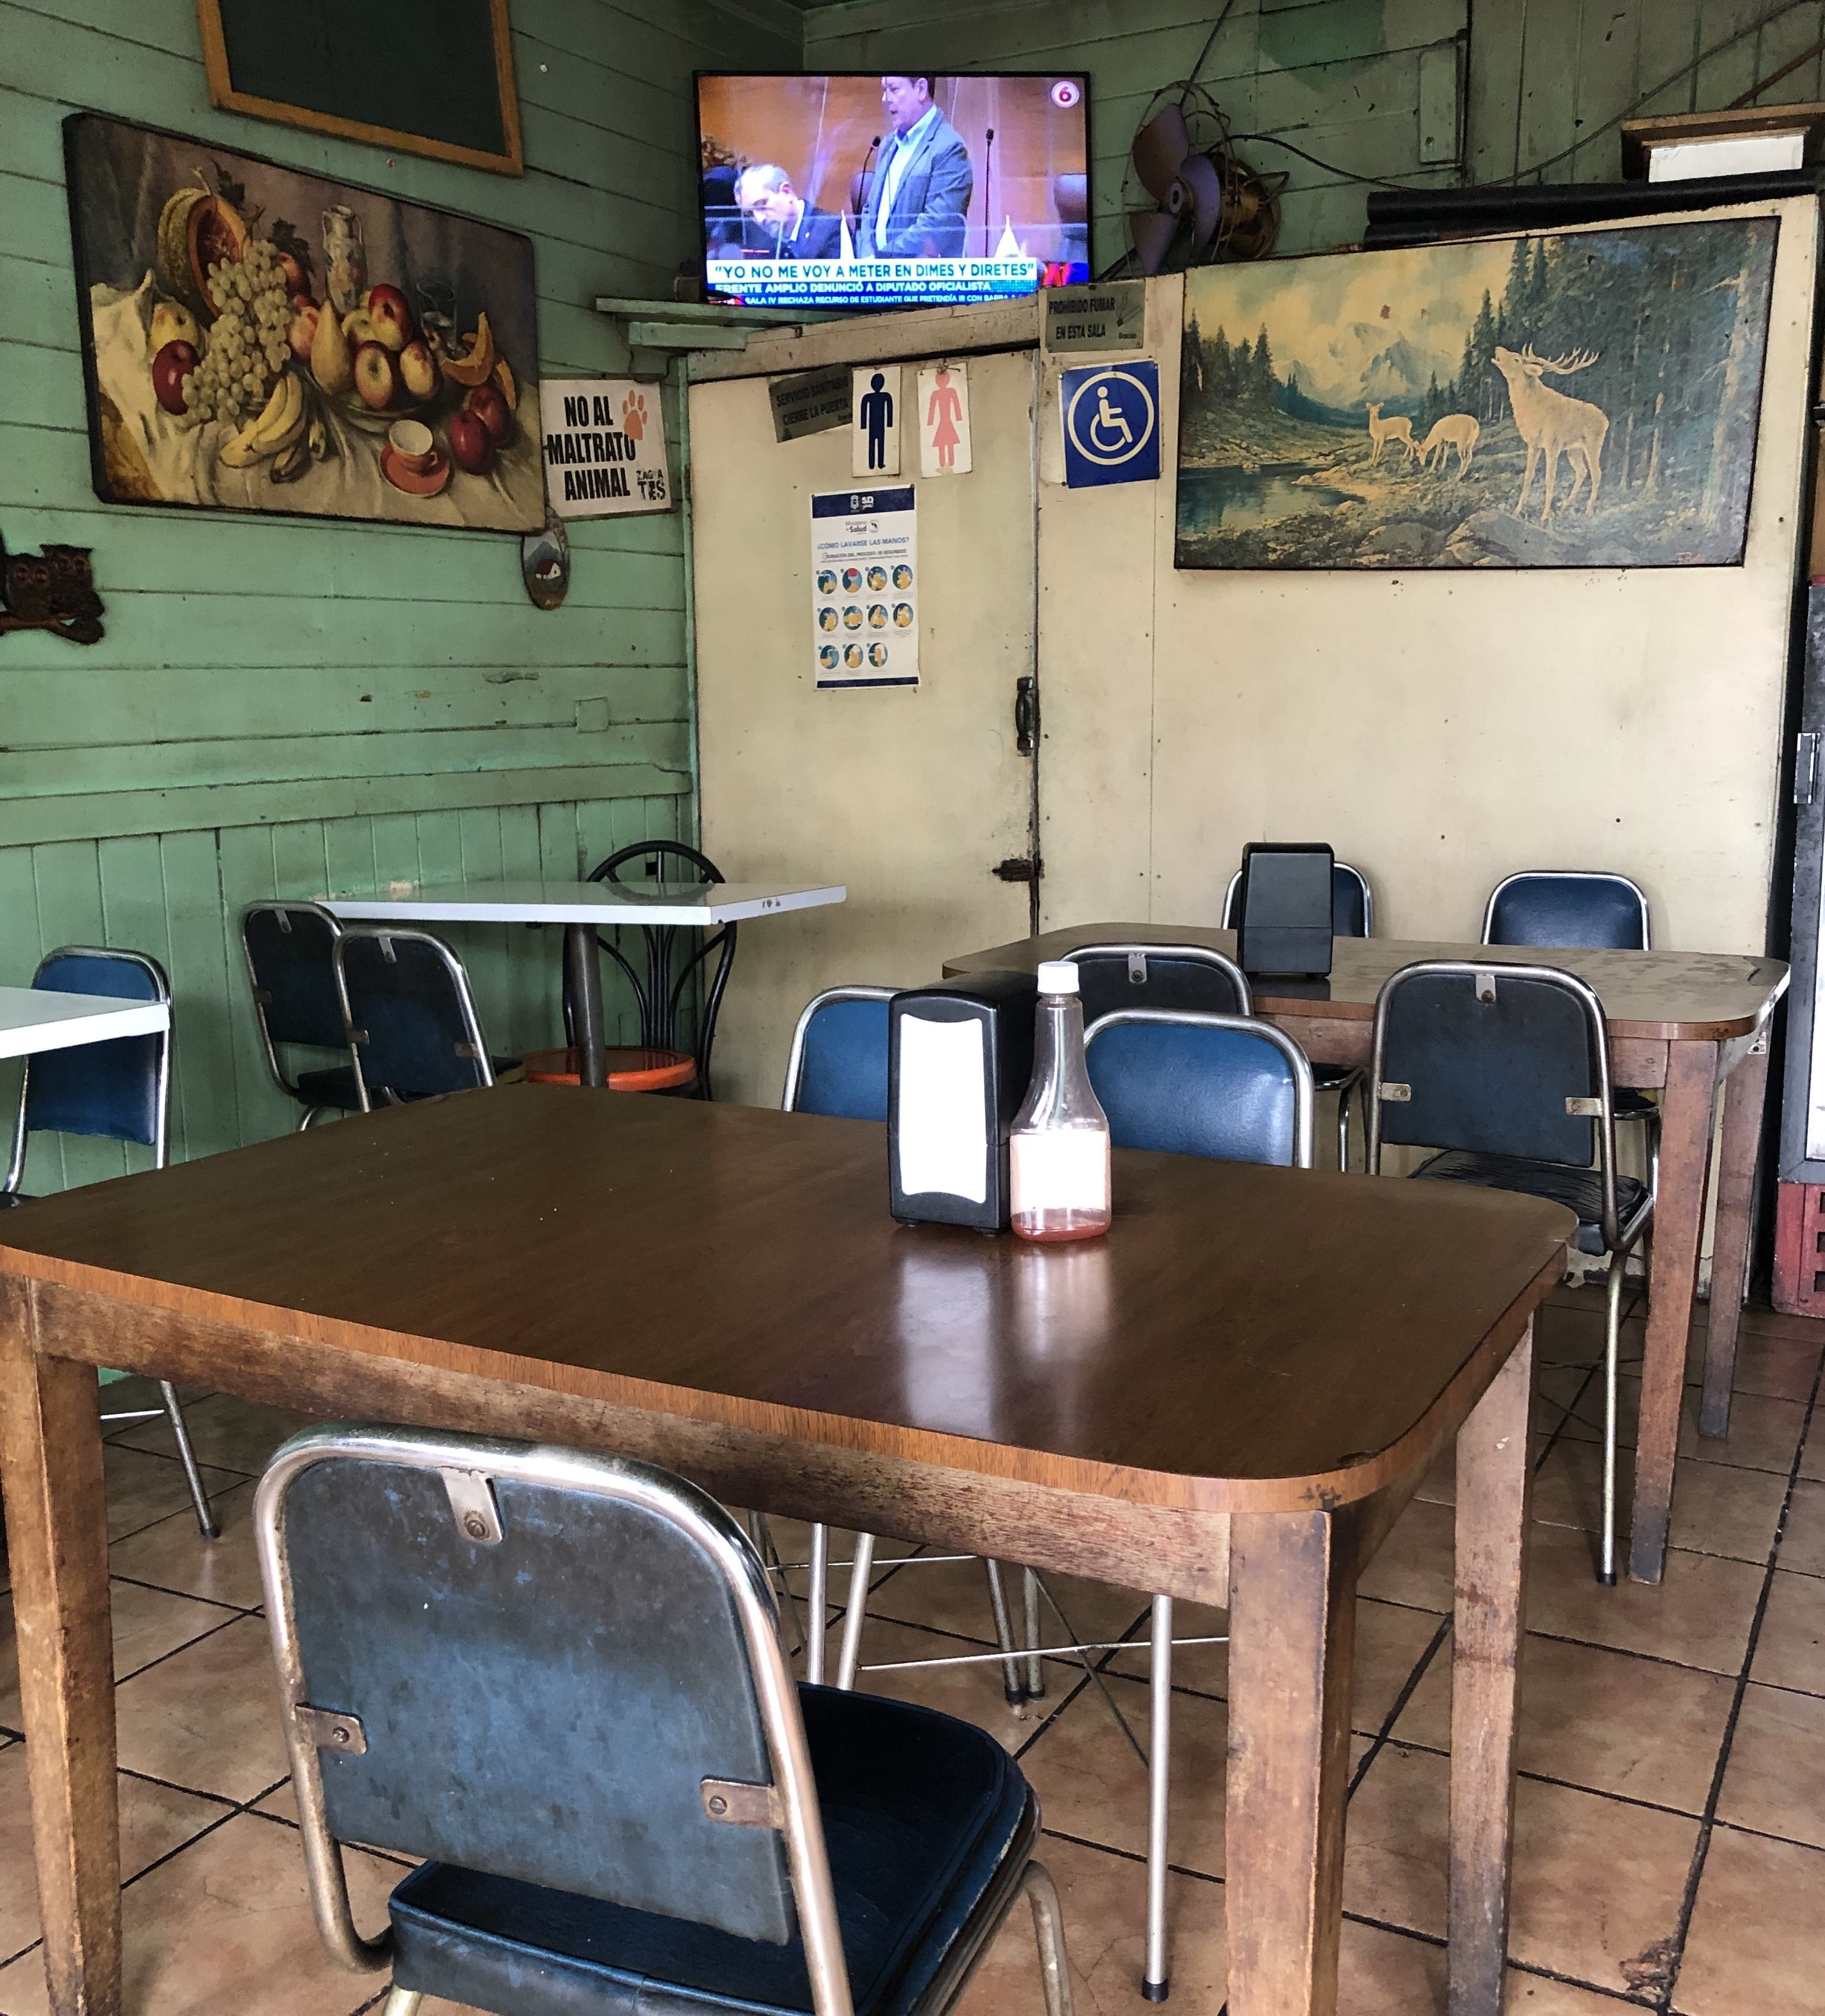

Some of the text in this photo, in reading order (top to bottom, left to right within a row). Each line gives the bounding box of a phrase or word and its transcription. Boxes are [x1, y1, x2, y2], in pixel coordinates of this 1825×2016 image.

[1059, 85, 1072, 102] 6
[751, 265, 773, 278] NO
[778, 265, 798, 278] ME
[802, 265, 831, 278] VOY
[836, 265, 844, 278] A
[849, 264, 891, 278] METER
[895, 264, 912, 277] EN
[916, 264, 954, 277] DIMES
[959, 264, 966, 276] Y
[766, 283, 807, 293] AMPLIO
[810, 282, 863, 293] DENUNCIÓ
[866, 282, 874, 292] A
[876, 282, 926, 292] DIPUTADO
[929, 281, 991, 292] OFICIALISTA
[1049, 297, 1115, 314] PROHIBIDO FUMAR
[1056, 324, 1106, 340] EN ESTA SALA
[776, 388, 810, 407] SERVICIO
[564, 395, 614, 427] NO AL
[810, 405, 819, 418] LA
[547, 432, 636, 464] MALTRATO
[564, 467, 631, 501] ANIMAL
